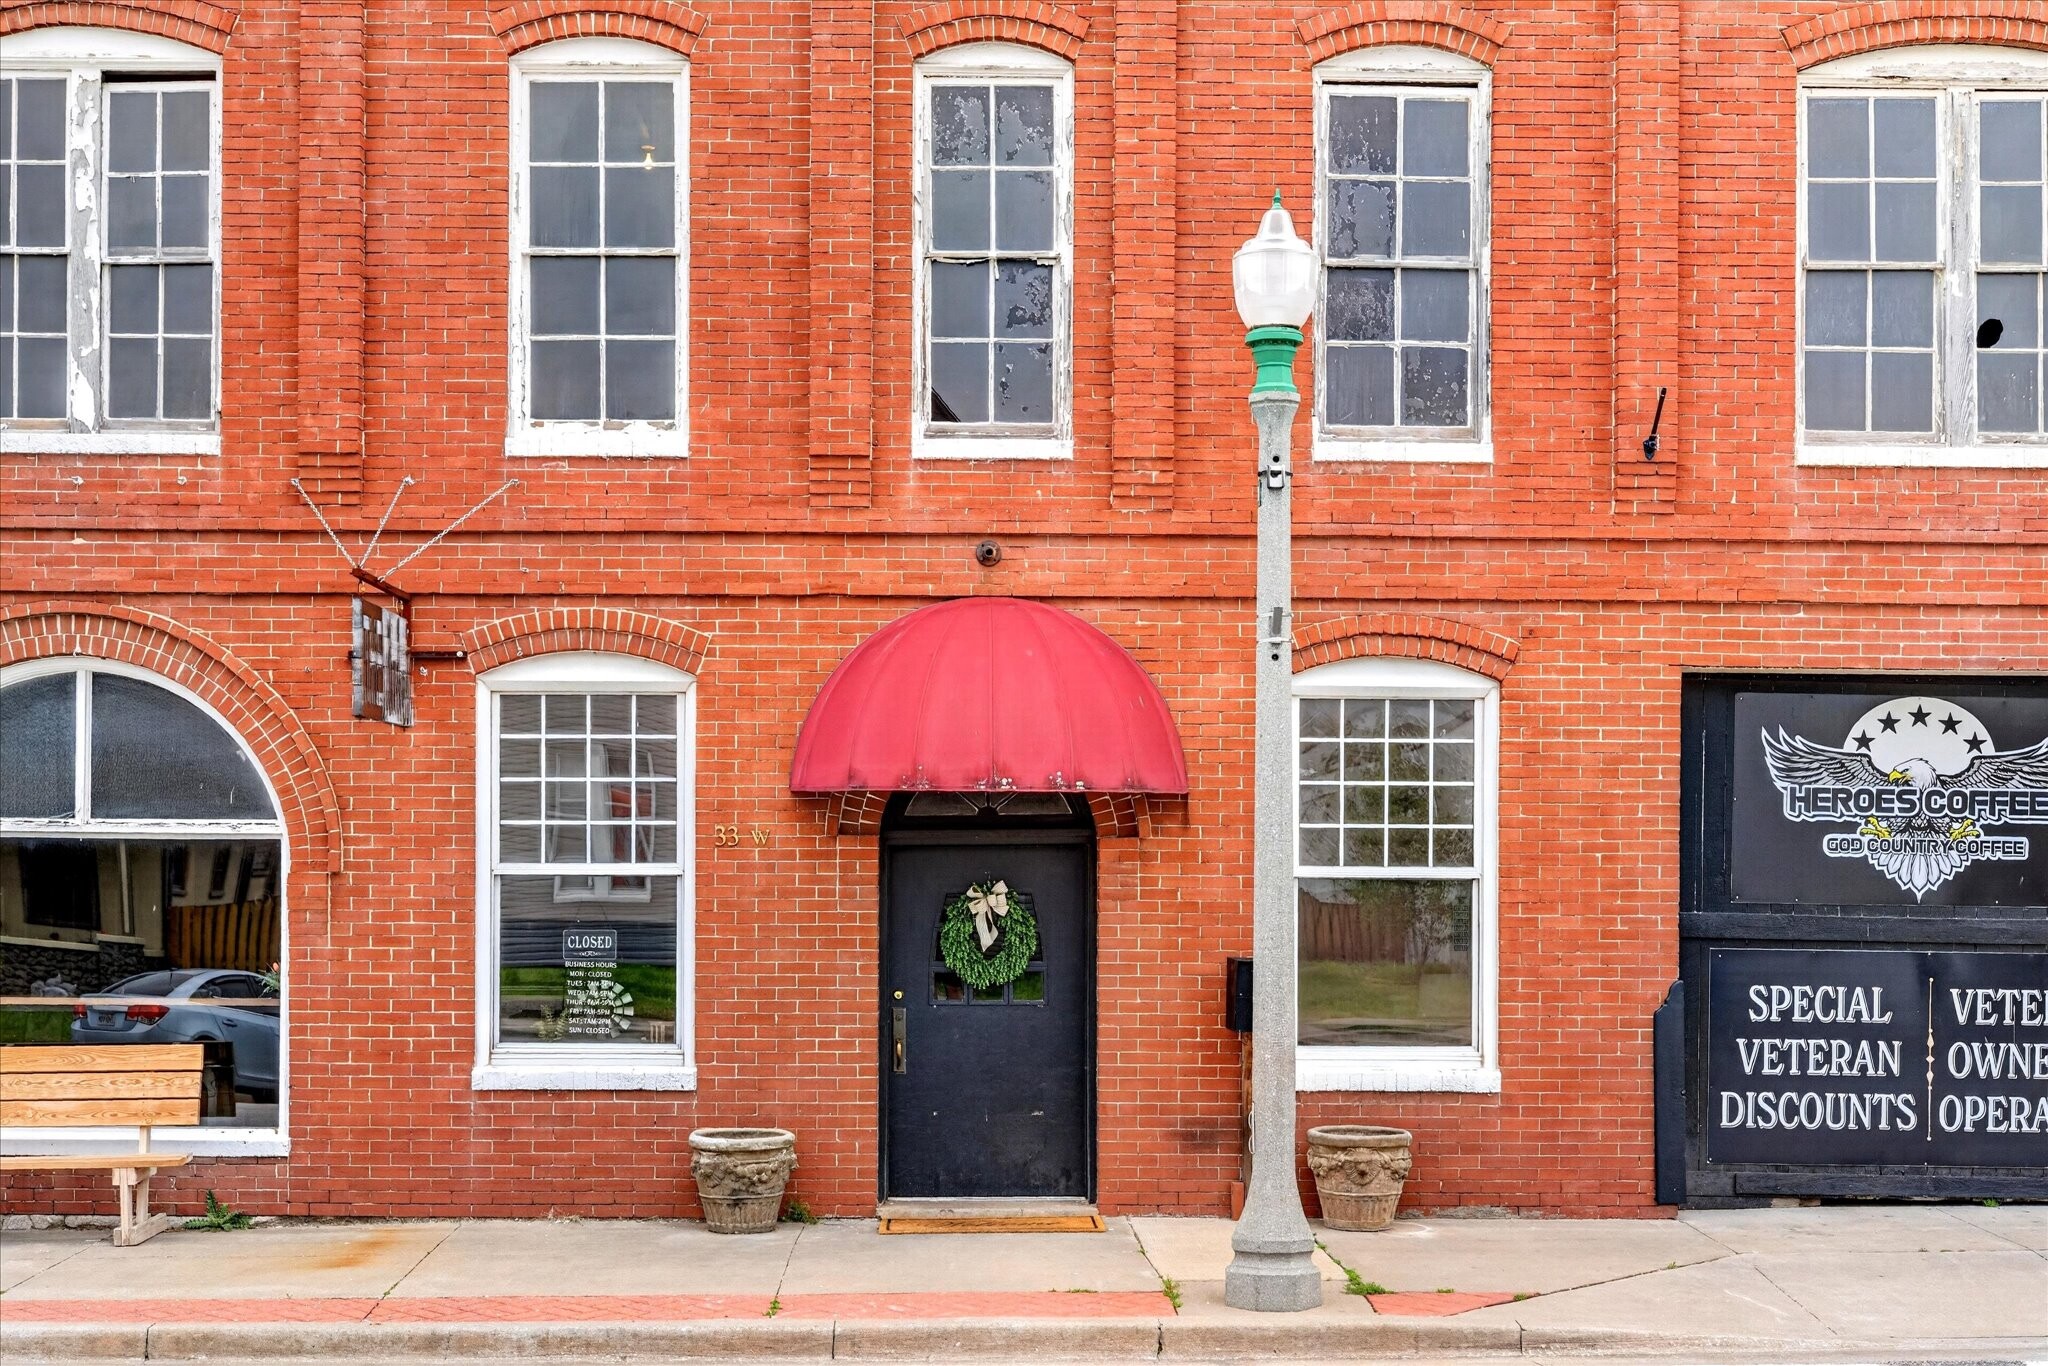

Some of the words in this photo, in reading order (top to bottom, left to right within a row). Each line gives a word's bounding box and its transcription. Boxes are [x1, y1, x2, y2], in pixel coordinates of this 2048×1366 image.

[1787, 786, 1920, 819] HEROES
[1923, 787, 2048, 822] COFFEE
[714, 825, 739, 847] 33
[751, 829, 770, 845] W
[1826, 837, 1863, 854] GOD
[1867, 838, 1951, 856] COUNTRY
[1955, 839, 2026, 857] COFFEE
[567, 935, 612, 949] CLOSED
[1748, 984, 1894, 1024] SPECIAL
[1950, 988, 2048, 1026] VETE
[1735, 1038, 1903, 1077] VETERAN
[1720, 1091, 1918, 1131] DISCOUNTS
